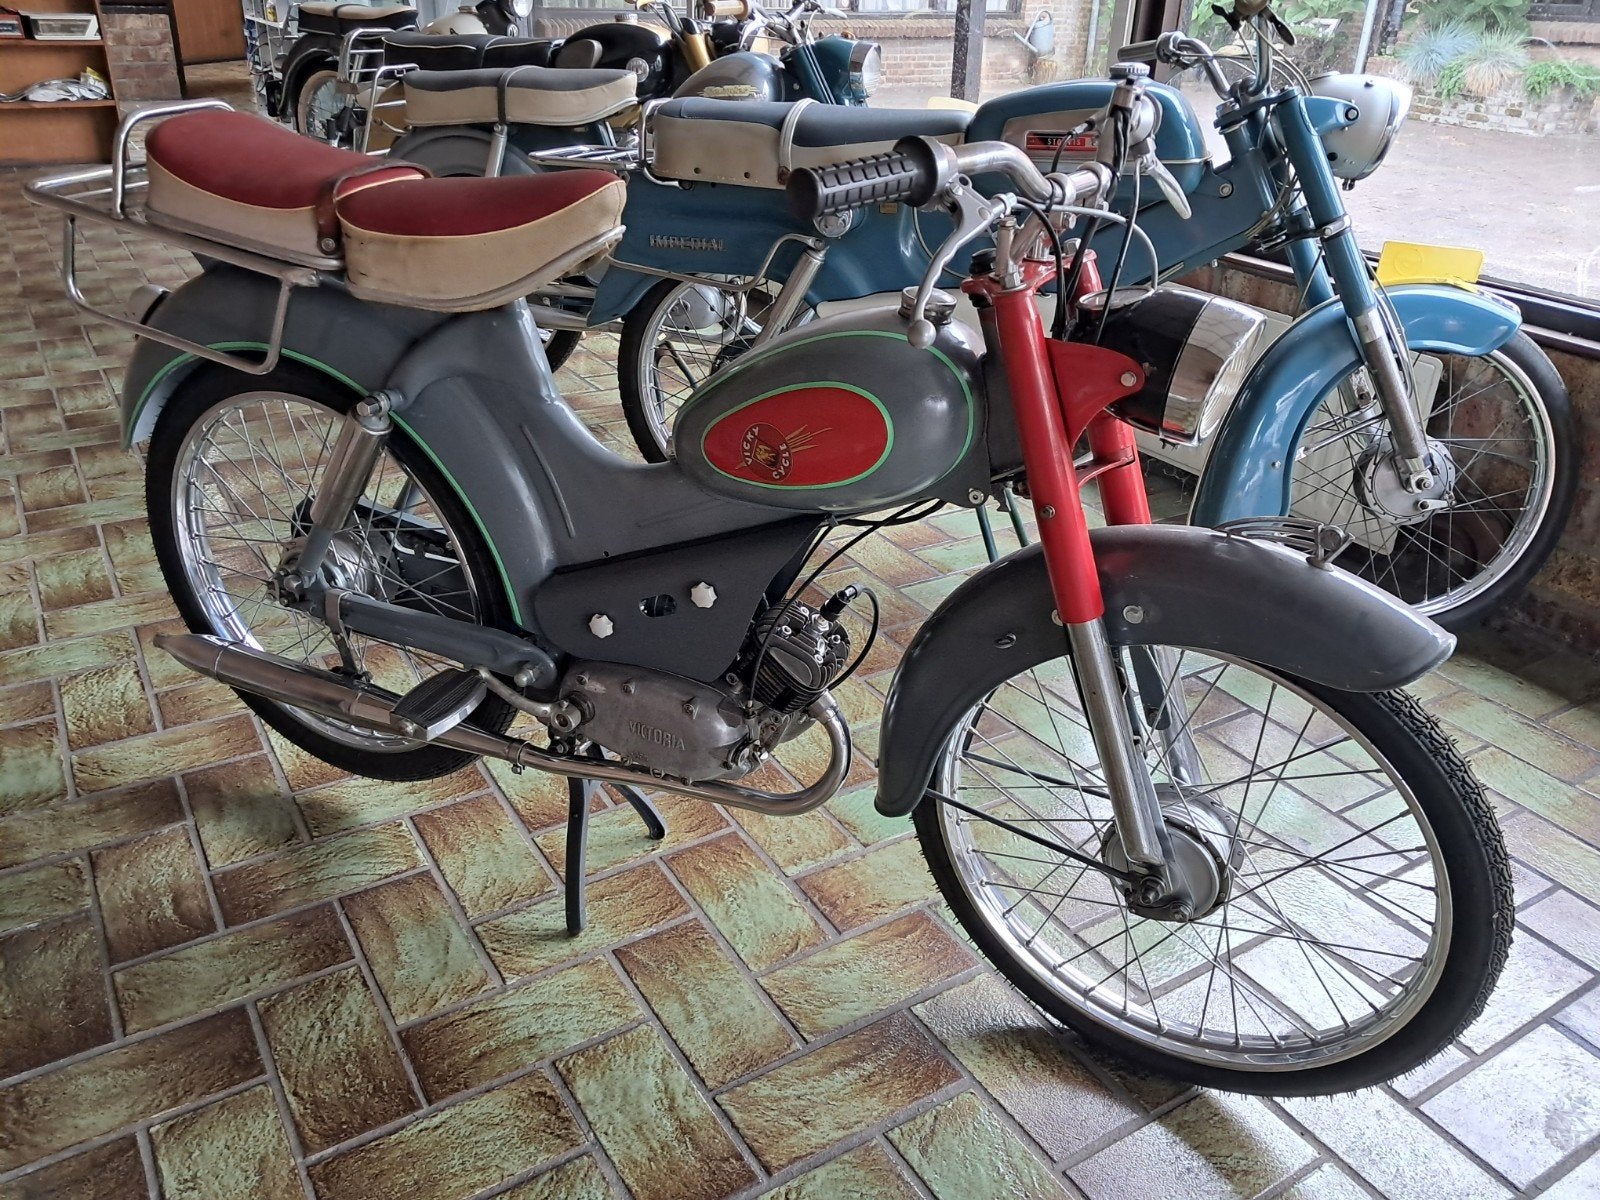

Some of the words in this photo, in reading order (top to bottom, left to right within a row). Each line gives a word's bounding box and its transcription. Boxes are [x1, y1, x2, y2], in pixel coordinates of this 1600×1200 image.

[1047, 138, 1081, 146] STOVIS
[649, 234, 727, 252] IMPERIAL
[743, 426, 759, 465] VICKY
[772, 443, 790, 479] CYCLE
[629, 720, 685, 751] VICTORIA
